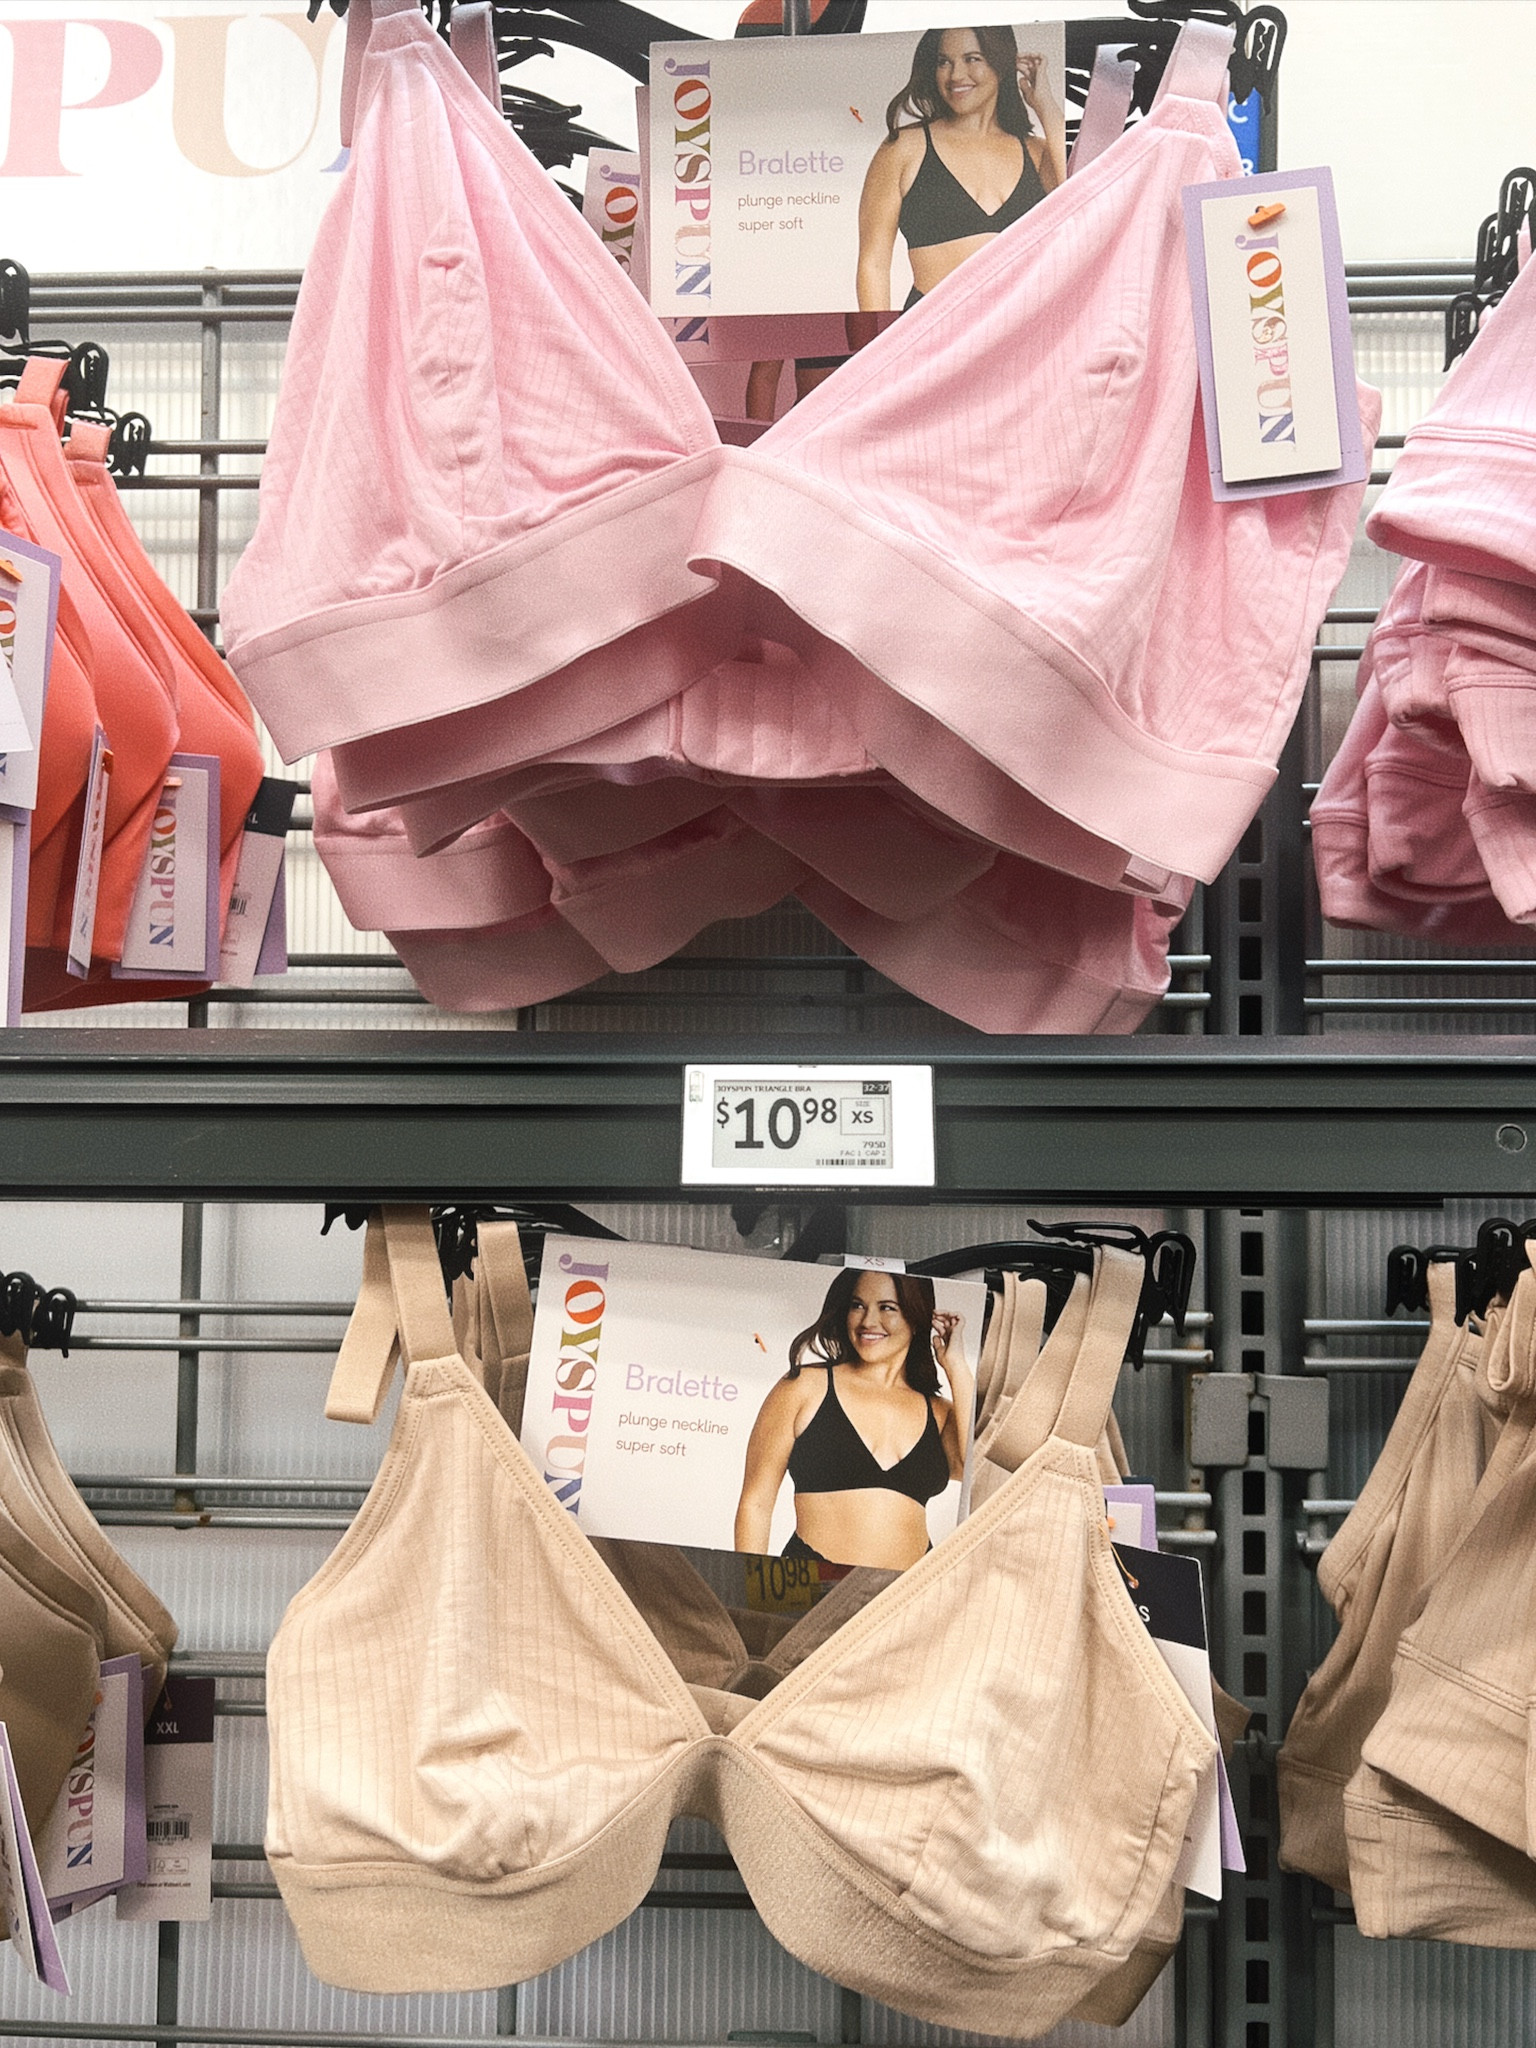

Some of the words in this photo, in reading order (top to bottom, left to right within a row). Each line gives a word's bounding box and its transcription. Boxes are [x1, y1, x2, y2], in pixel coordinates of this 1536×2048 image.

[0, 13, 350, 179] PU
[738, 150, 844, 177] Bralette
[663, 57, 712, 301] JOYSPUN
[737, 193, 783, 210] plunge
[787, 191, 841, 206] neckline
[737, 219, 775, 233] super
[778, 216, 804, 231] soft
[1234, 232, 1297, 446] JOYSPUN
[851, 1110, 874, 1124] XS
[624, 1363, 739, 1402] Bralette
[617, 1411, 668, 1431] plunge
[671, 1417, 729, 1435] neckline
[615, 1438, 656, 1457] super
[659, 1440, 687, 1457] soft
[155, 1721, 180, 1735] XXL
